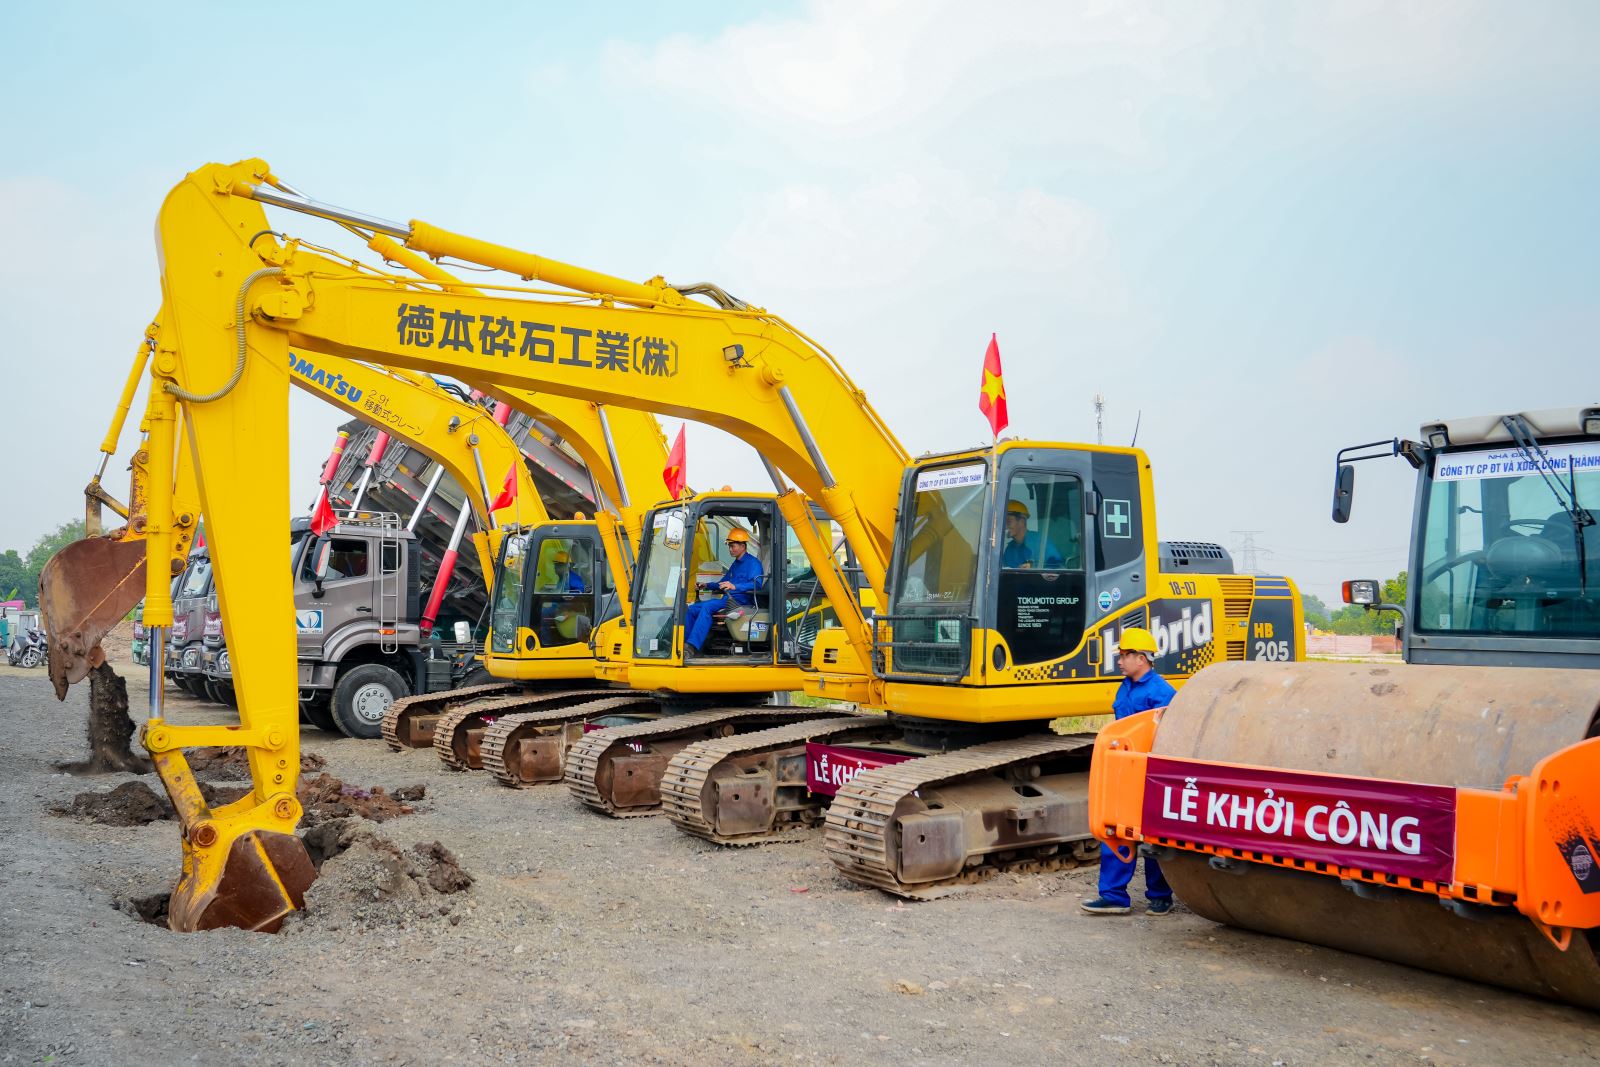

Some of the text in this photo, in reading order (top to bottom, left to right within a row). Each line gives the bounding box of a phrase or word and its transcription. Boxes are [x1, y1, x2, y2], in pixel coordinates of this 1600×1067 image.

[1440, 465, 1463, 477] CÔNG
[1465, 464, 1475, 475] TY
[1477, 464, 1487, 474] CP
[1490, 462, 1501, 473] ĐT
[1503, 460, 1514, 473] VÀ
[1169, 581, 1197, 596] 18-07
[1017, 596, 1079, 605] TOKUMOTO GROUP
[1103, 601, 1212, 674] Hbrid
[1253, 622, 1274, 638] HB
[1254, 640, 1290, 662] 205
[813, 754, 831, 784] LỄ
[1162, 777, 1421, 855] LỄ KHỞI CÔNG
